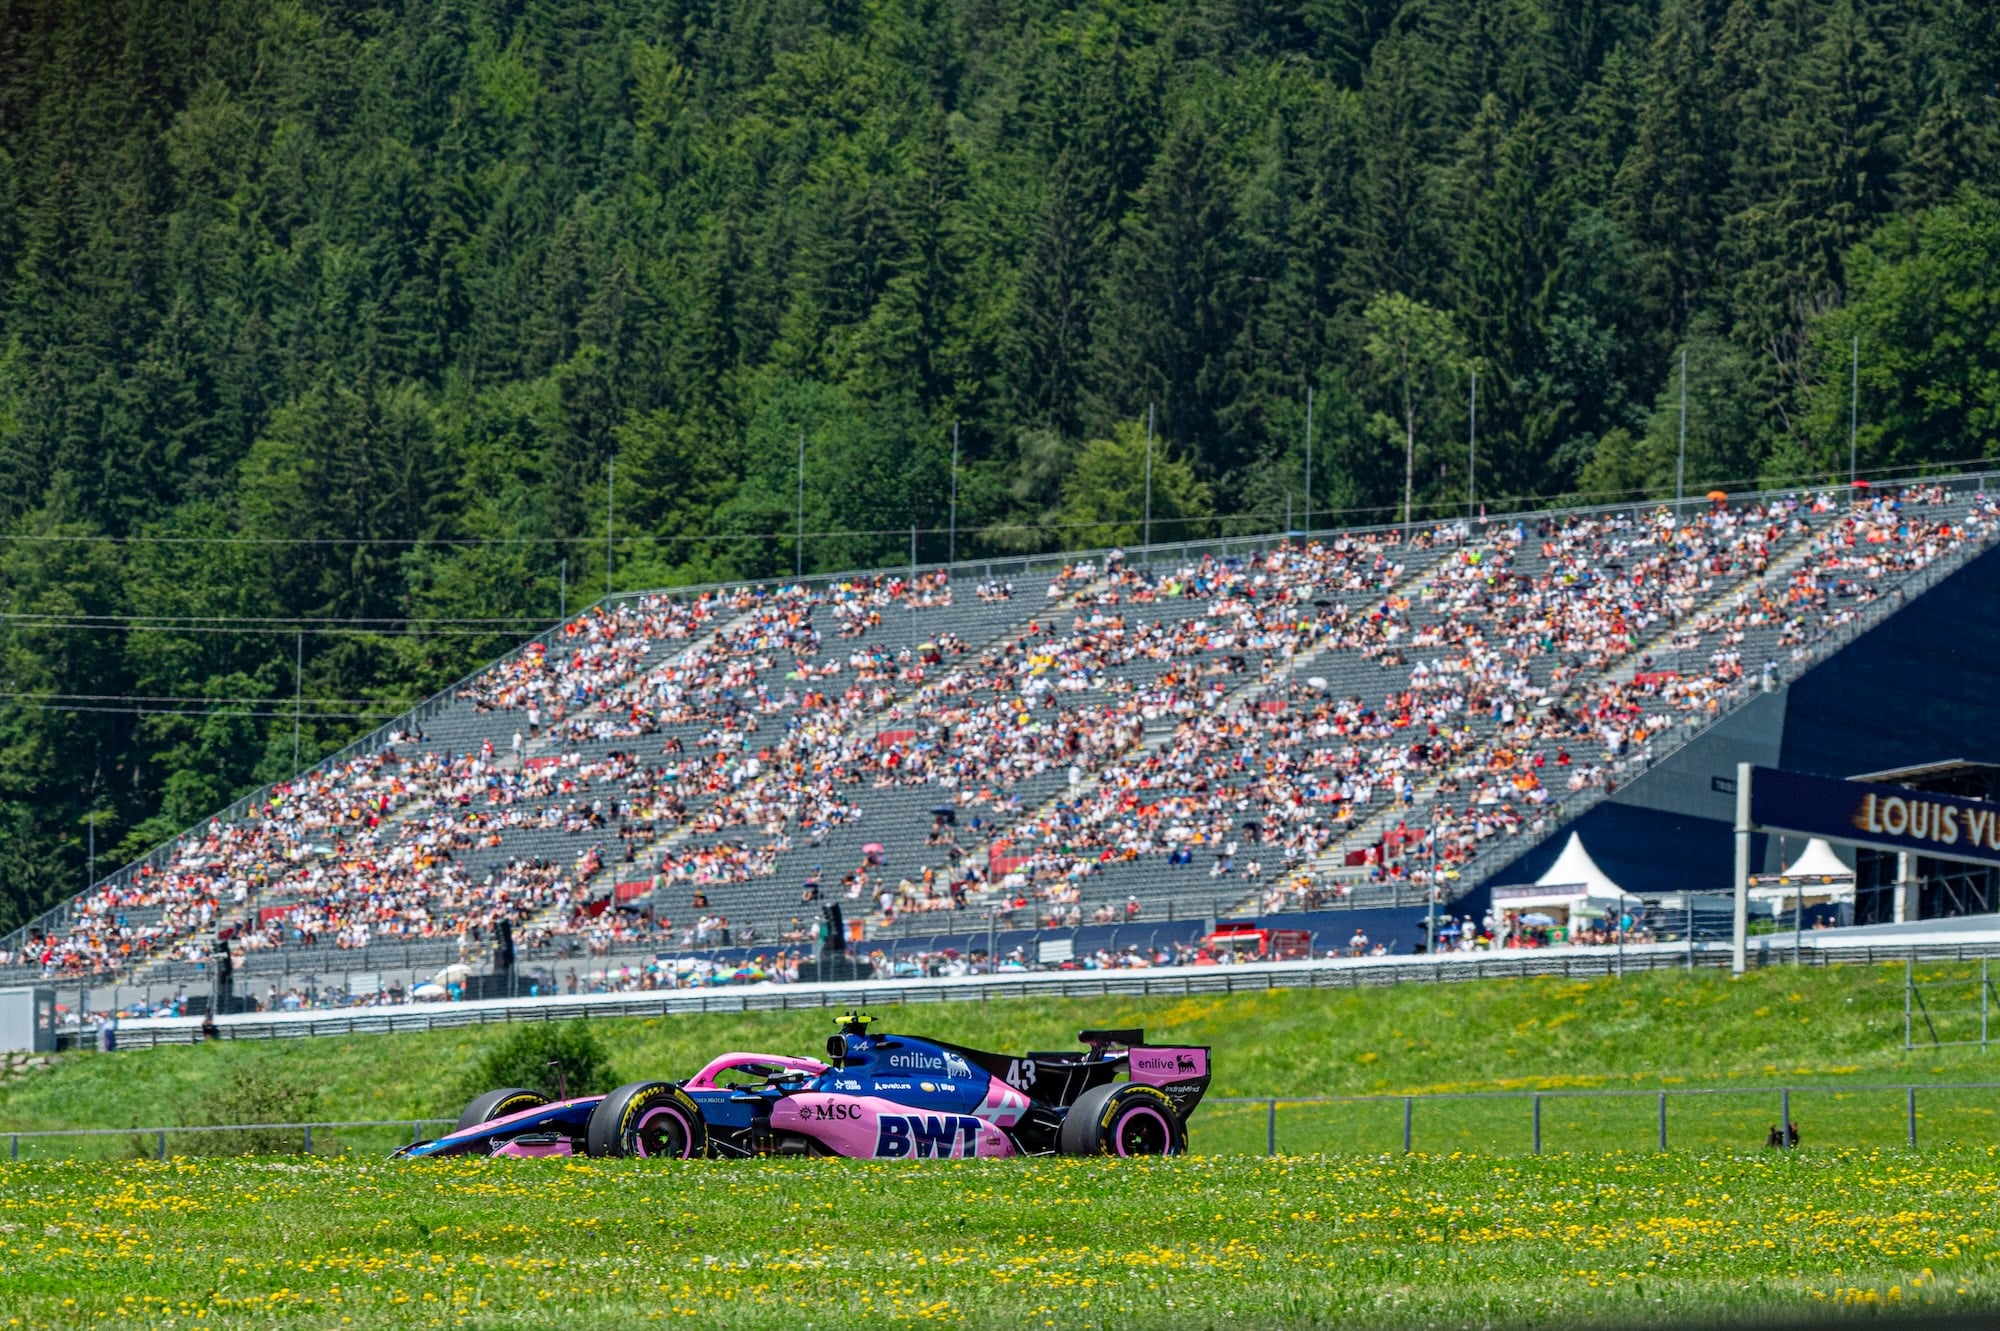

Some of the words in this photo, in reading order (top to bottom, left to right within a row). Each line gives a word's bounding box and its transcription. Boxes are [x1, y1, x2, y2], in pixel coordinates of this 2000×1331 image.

[1867, 792, 1959, 845] LOUIS
[889, 1052, 942, 1069] enilive
[1138, 1058, 1174, 1069] enilive
[1006, 1059, 1036, 1090] 43
[815, 1104, 861, 1120] MSC
[874, 1114, 983, 1158] BWT
